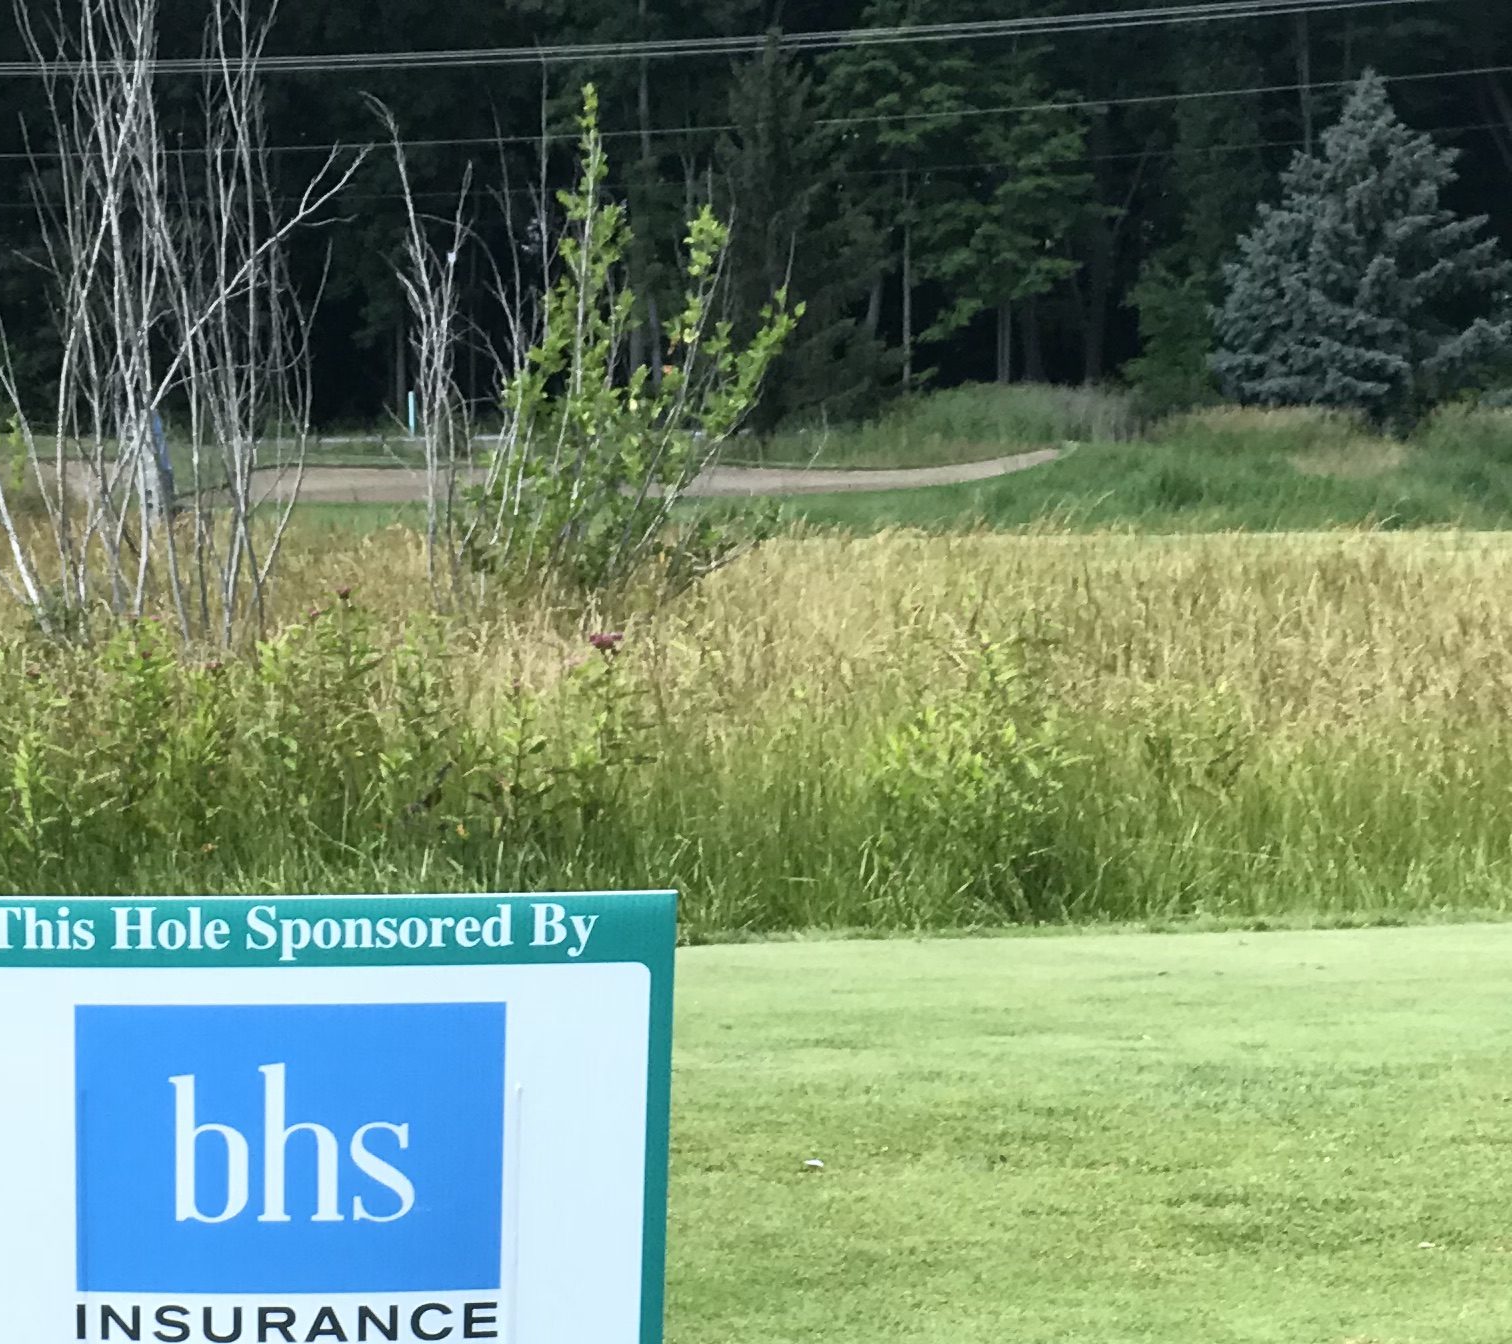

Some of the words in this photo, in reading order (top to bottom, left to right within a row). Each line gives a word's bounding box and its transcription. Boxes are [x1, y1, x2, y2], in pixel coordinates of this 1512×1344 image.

[109, 906, 231, 950] Hole
[244, 904, 513, 961] Sponsored
[529, 903, 599, 957] By
[168, 1062, 415, 1223] bhs
[76, 1302, 498, 1343] INSURANCE
